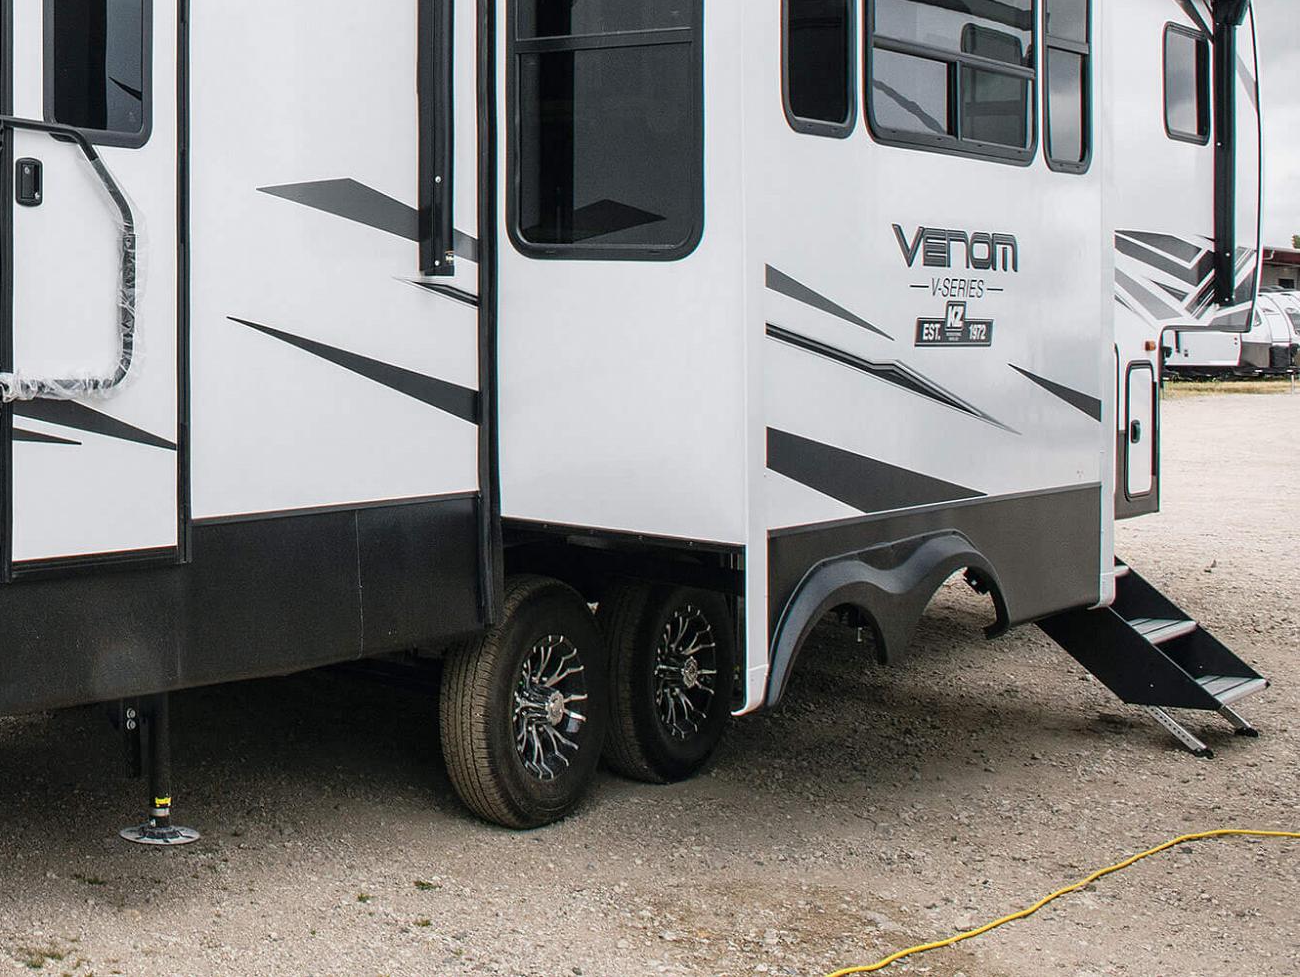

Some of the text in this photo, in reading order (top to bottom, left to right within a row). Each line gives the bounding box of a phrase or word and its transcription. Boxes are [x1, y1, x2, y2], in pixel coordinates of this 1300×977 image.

[892, 223, 1018, 273] VENOM
[931, 277, 984, 298] V-SERIES
[922, 323, 941, 341] EST.
[969, 324, 987, 340] 1972
